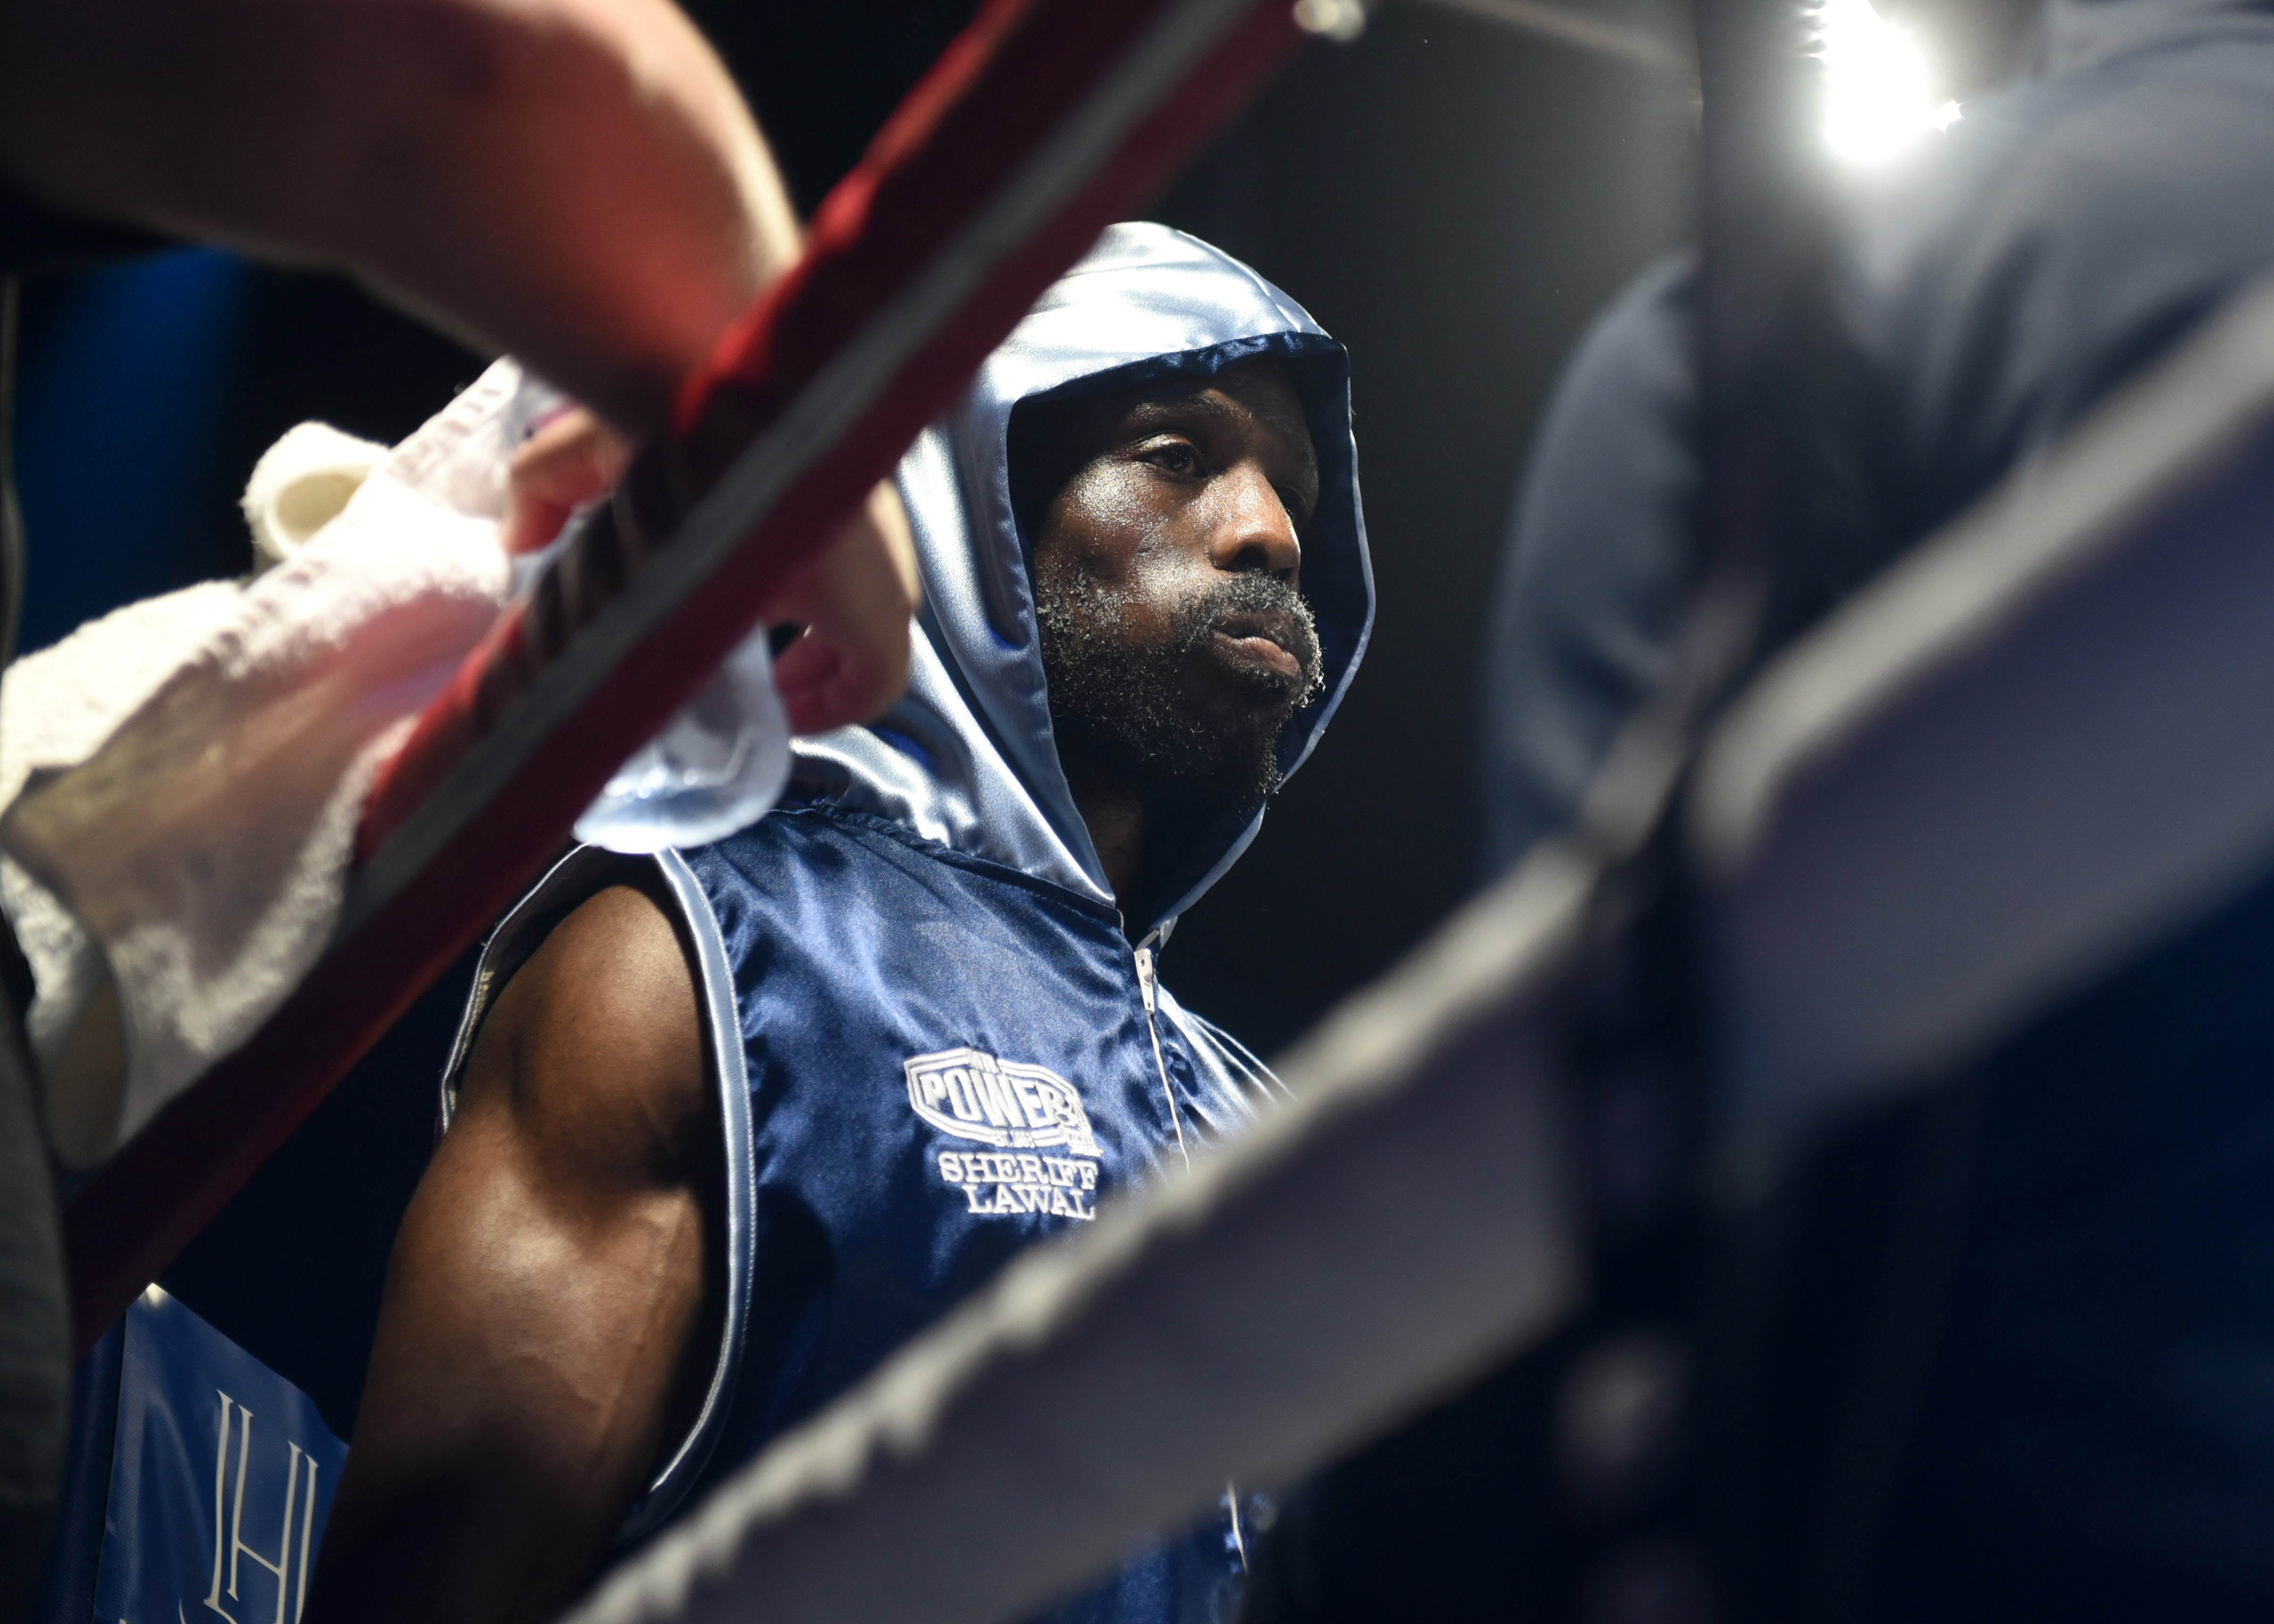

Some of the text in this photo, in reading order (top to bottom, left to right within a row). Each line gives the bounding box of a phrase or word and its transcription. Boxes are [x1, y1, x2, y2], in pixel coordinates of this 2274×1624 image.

[919, 1068, 1066, 1128] POWER
[938, 1152, 1098, 1190] SHERIFF
[961, 1184, 1095, 1220] LAWAL
